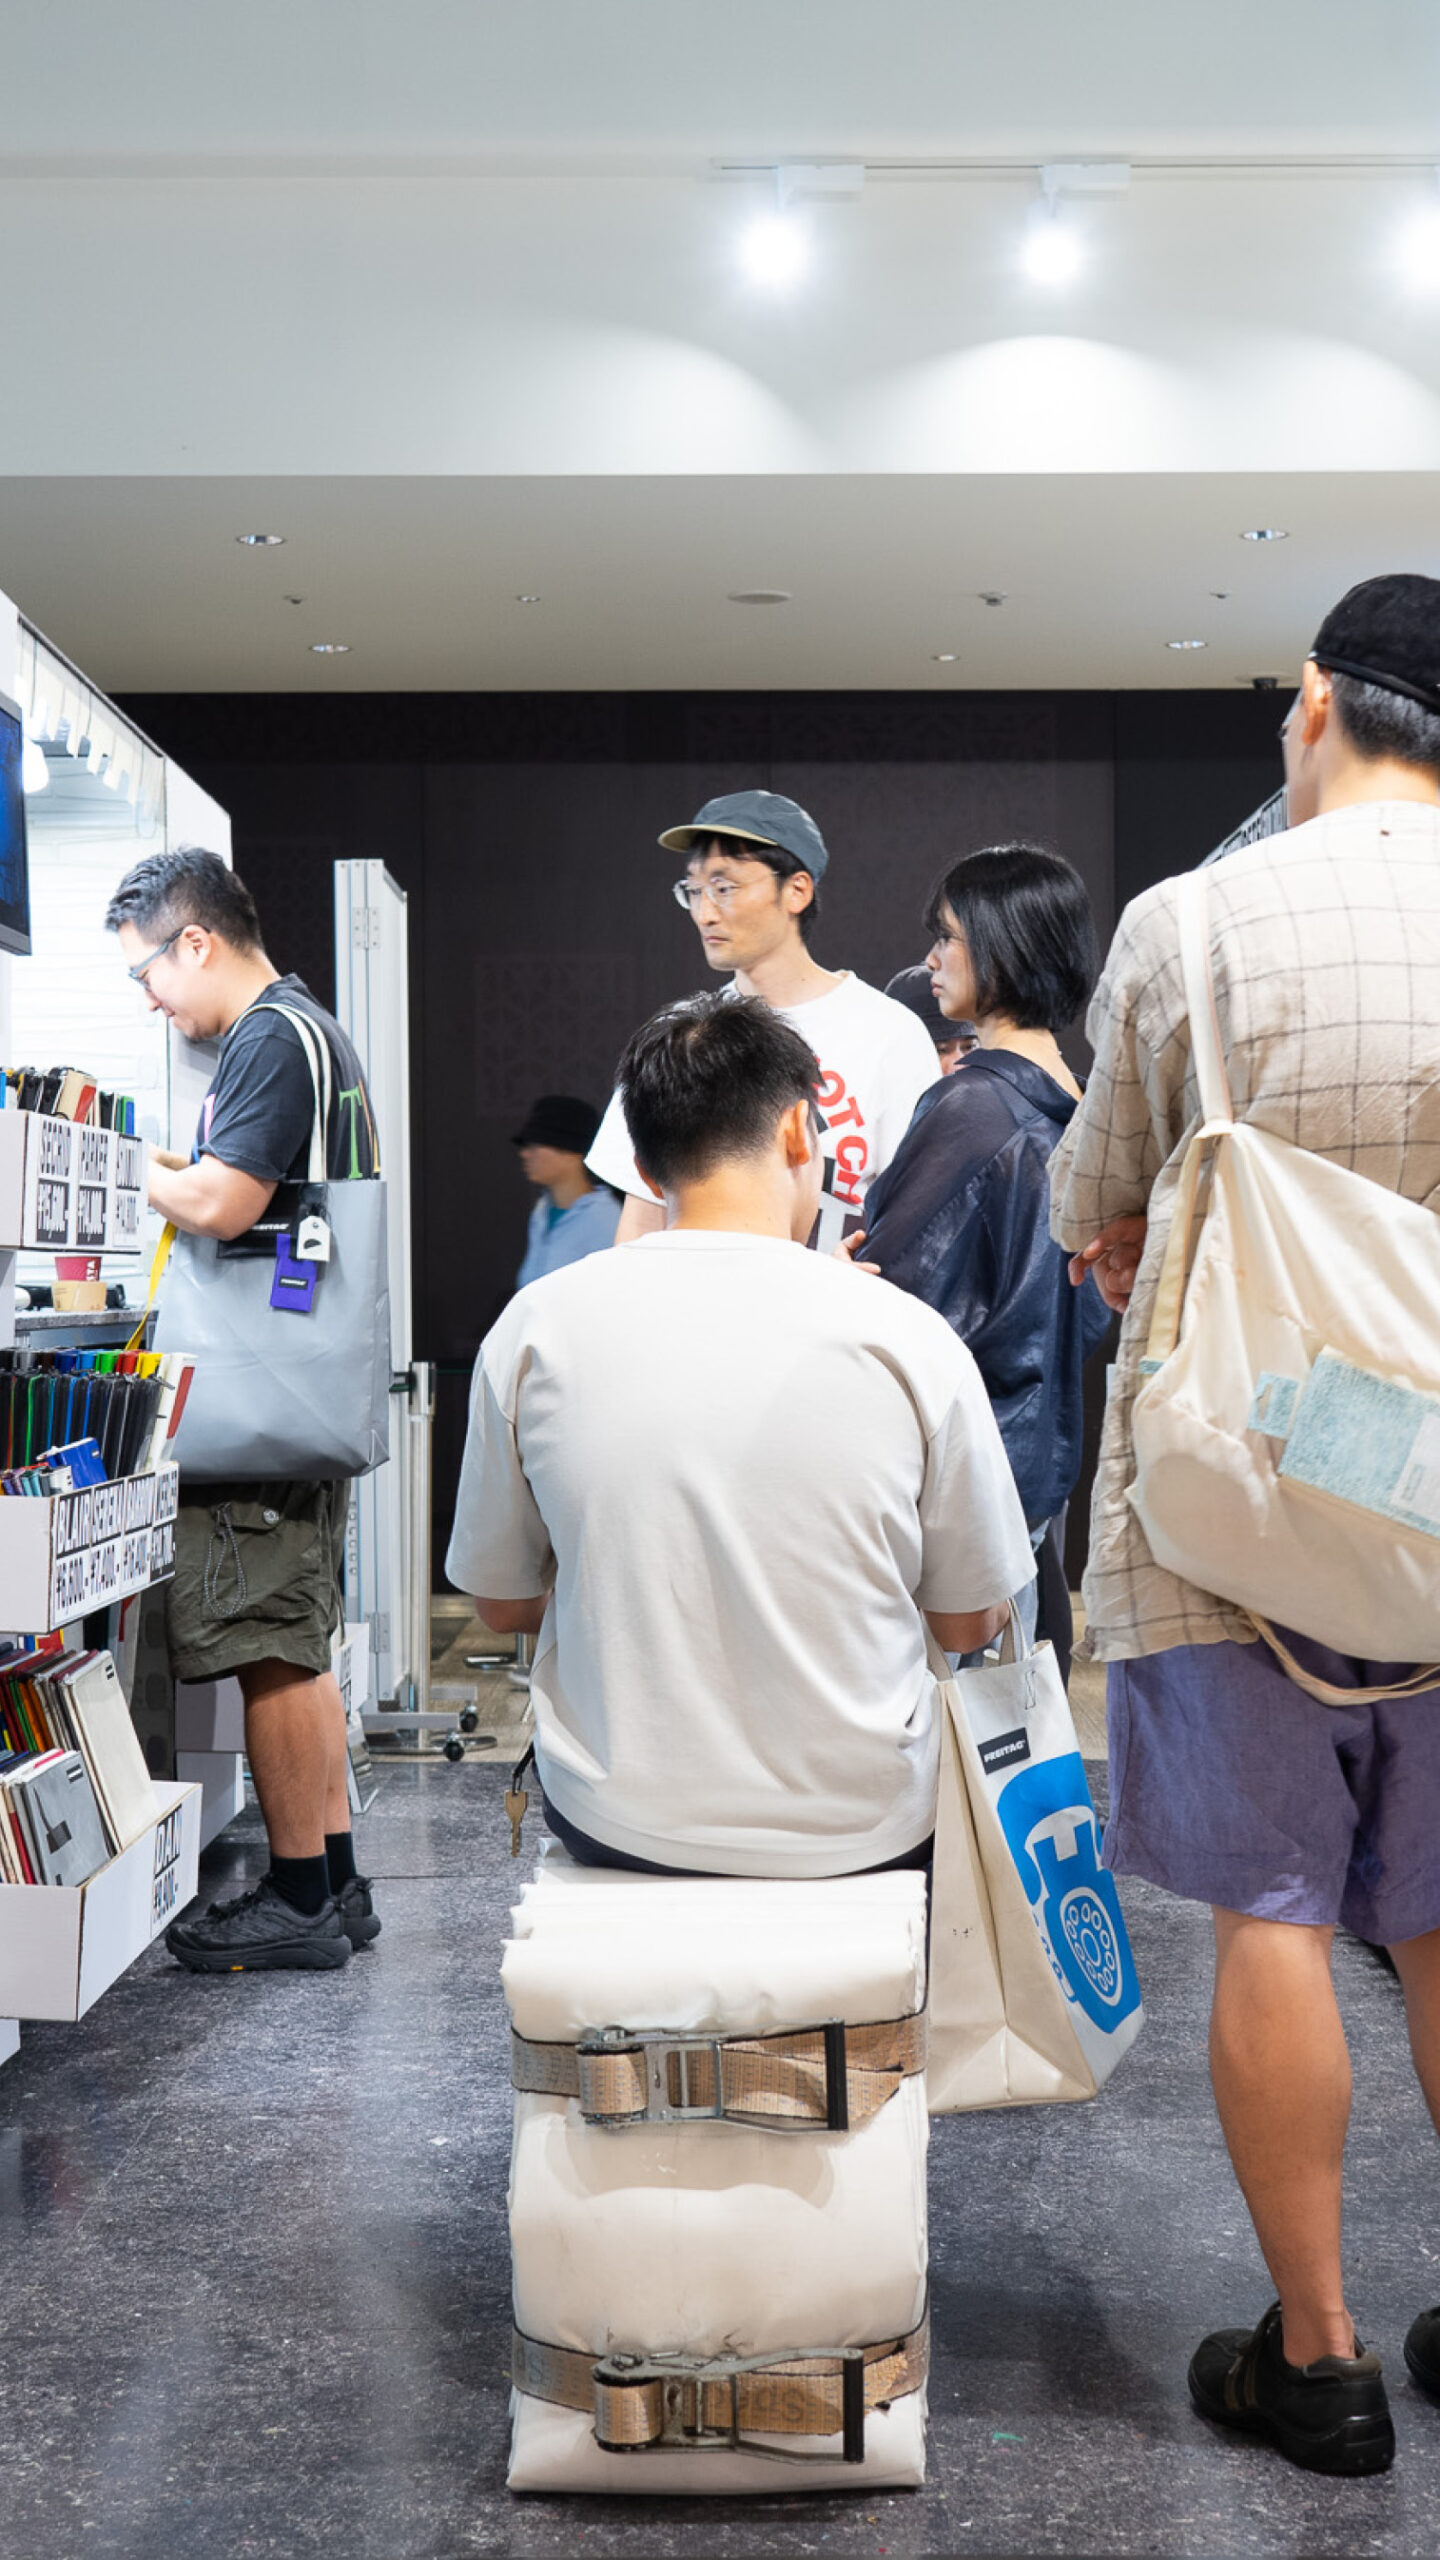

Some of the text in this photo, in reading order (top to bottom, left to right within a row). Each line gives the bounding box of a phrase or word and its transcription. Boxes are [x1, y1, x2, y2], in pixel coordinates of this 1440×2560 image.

[812, 1055, 868, 1205] OTCH
[57, 1494, 91, 1554] BLAIR
[983, 1739, 1026, 1763] FREITAG
[155, 1809, 182, 1876] DAN
